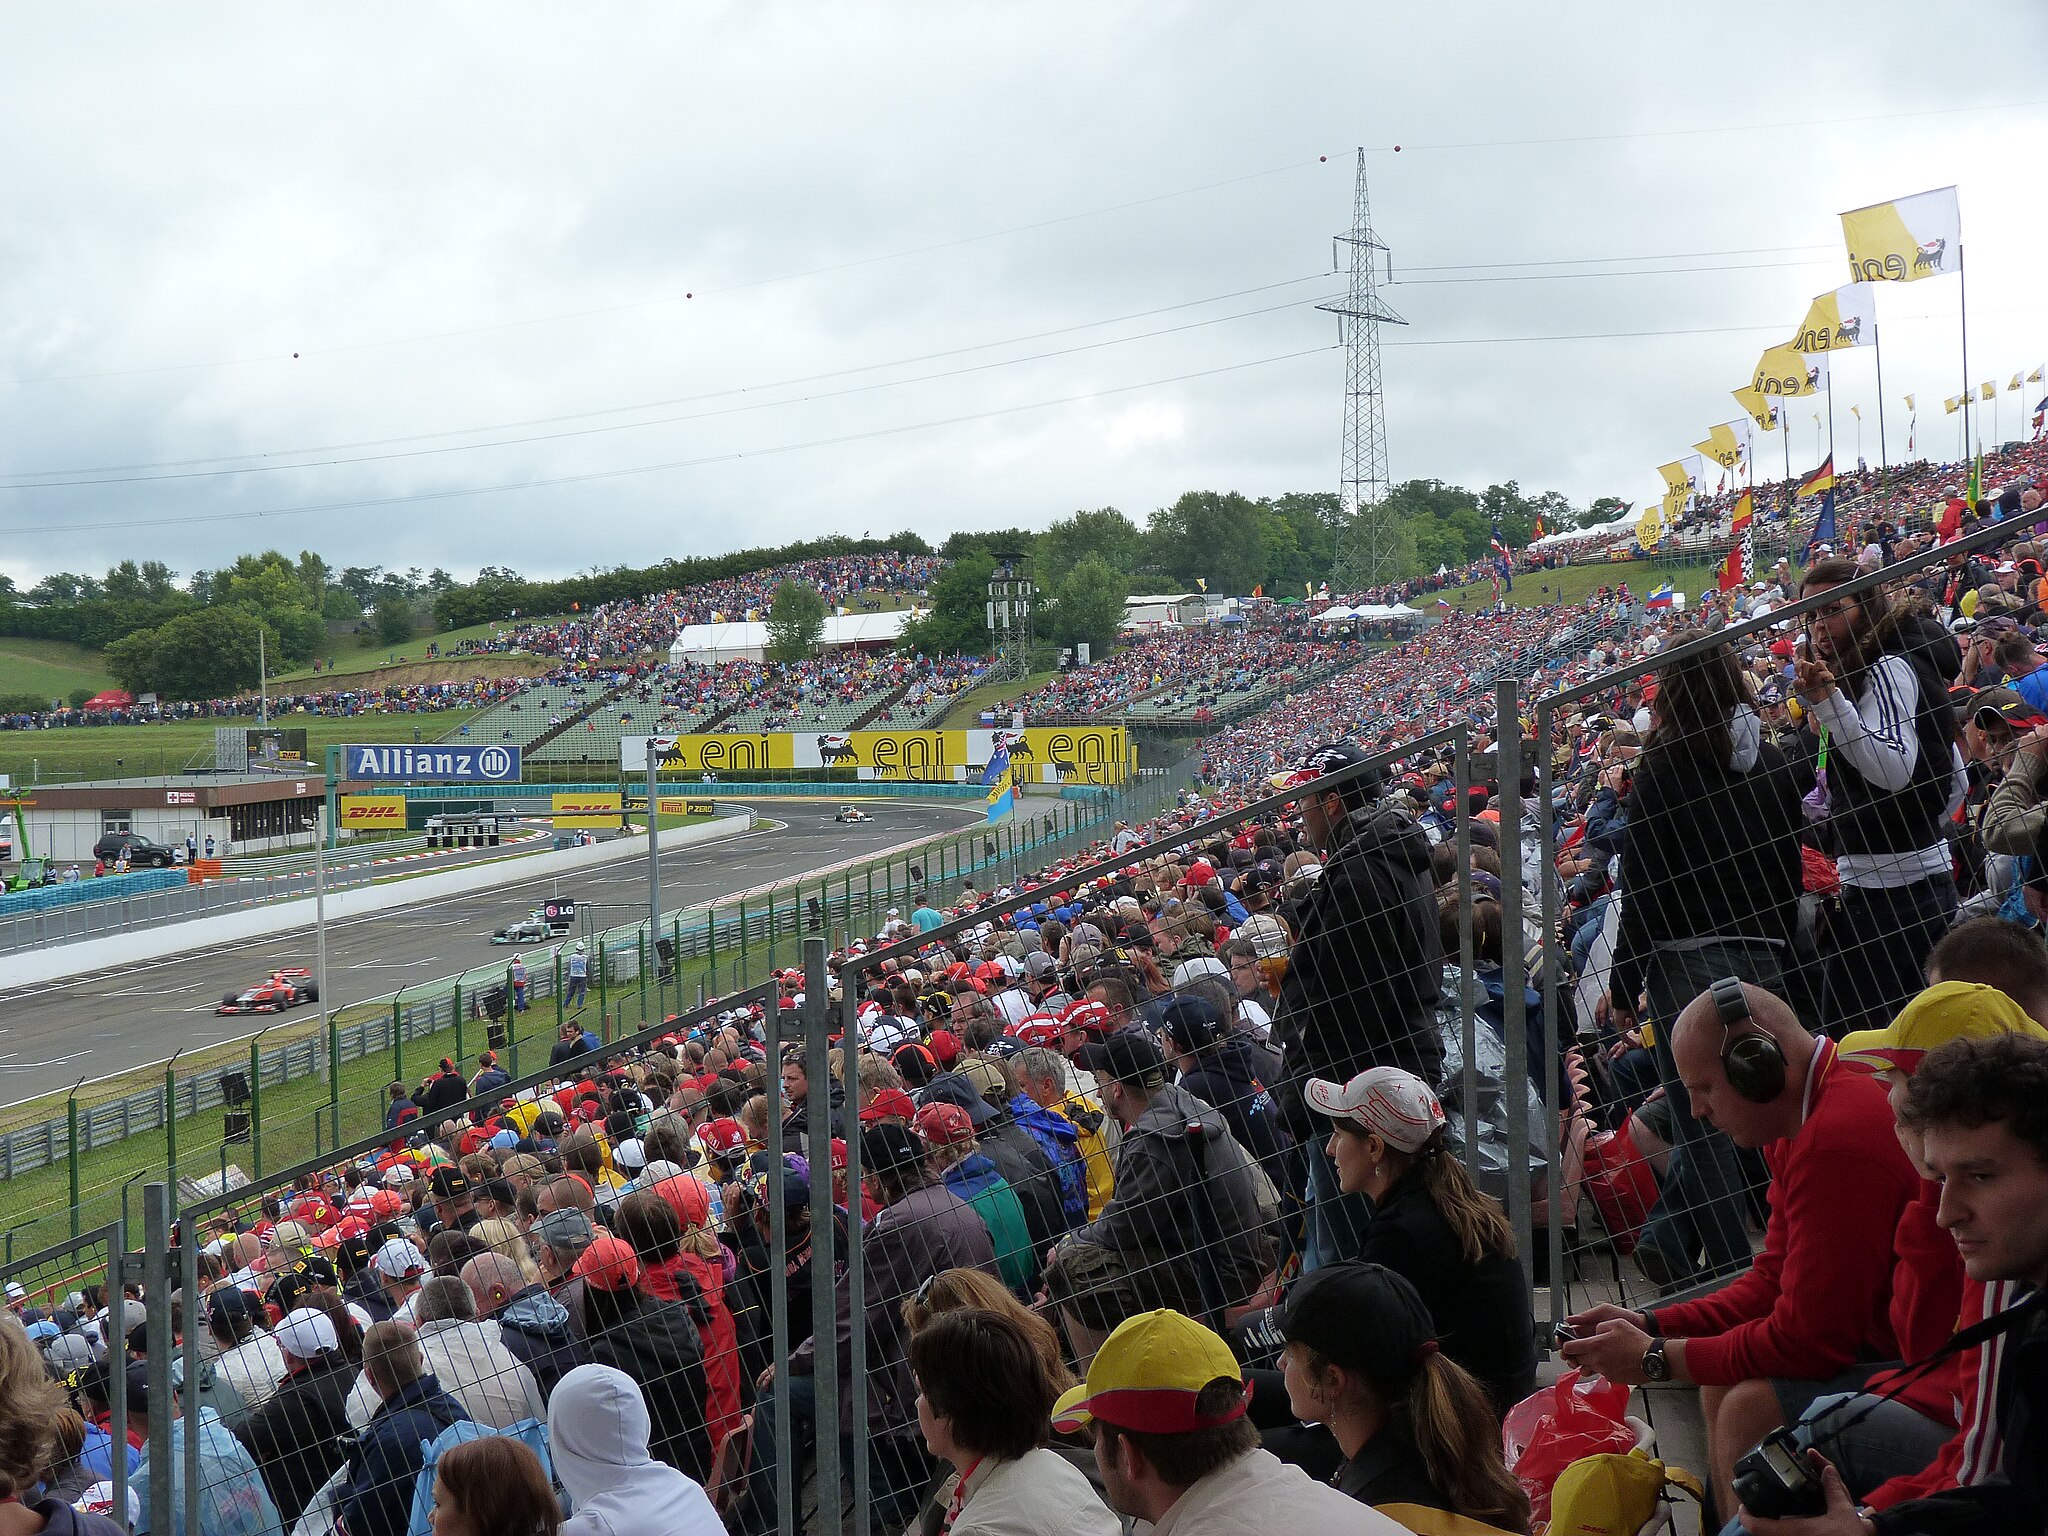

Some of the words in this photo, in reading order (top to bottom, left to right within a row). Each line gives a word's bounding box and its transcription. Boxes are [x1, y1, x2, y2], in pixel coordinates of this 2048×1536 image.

[700, 733, 769, 769] eni
[873, 731, 944, 767] eni
[1047, 727, 1120, 764] eni
[358, 748, 472, 775] Allianz
[348, 806, 400, 818] DHL
[661, 802, 683, 813] PIRELLI
[693, 804, 713, 812] ZERO
[560, 905, 574, 915] LG
